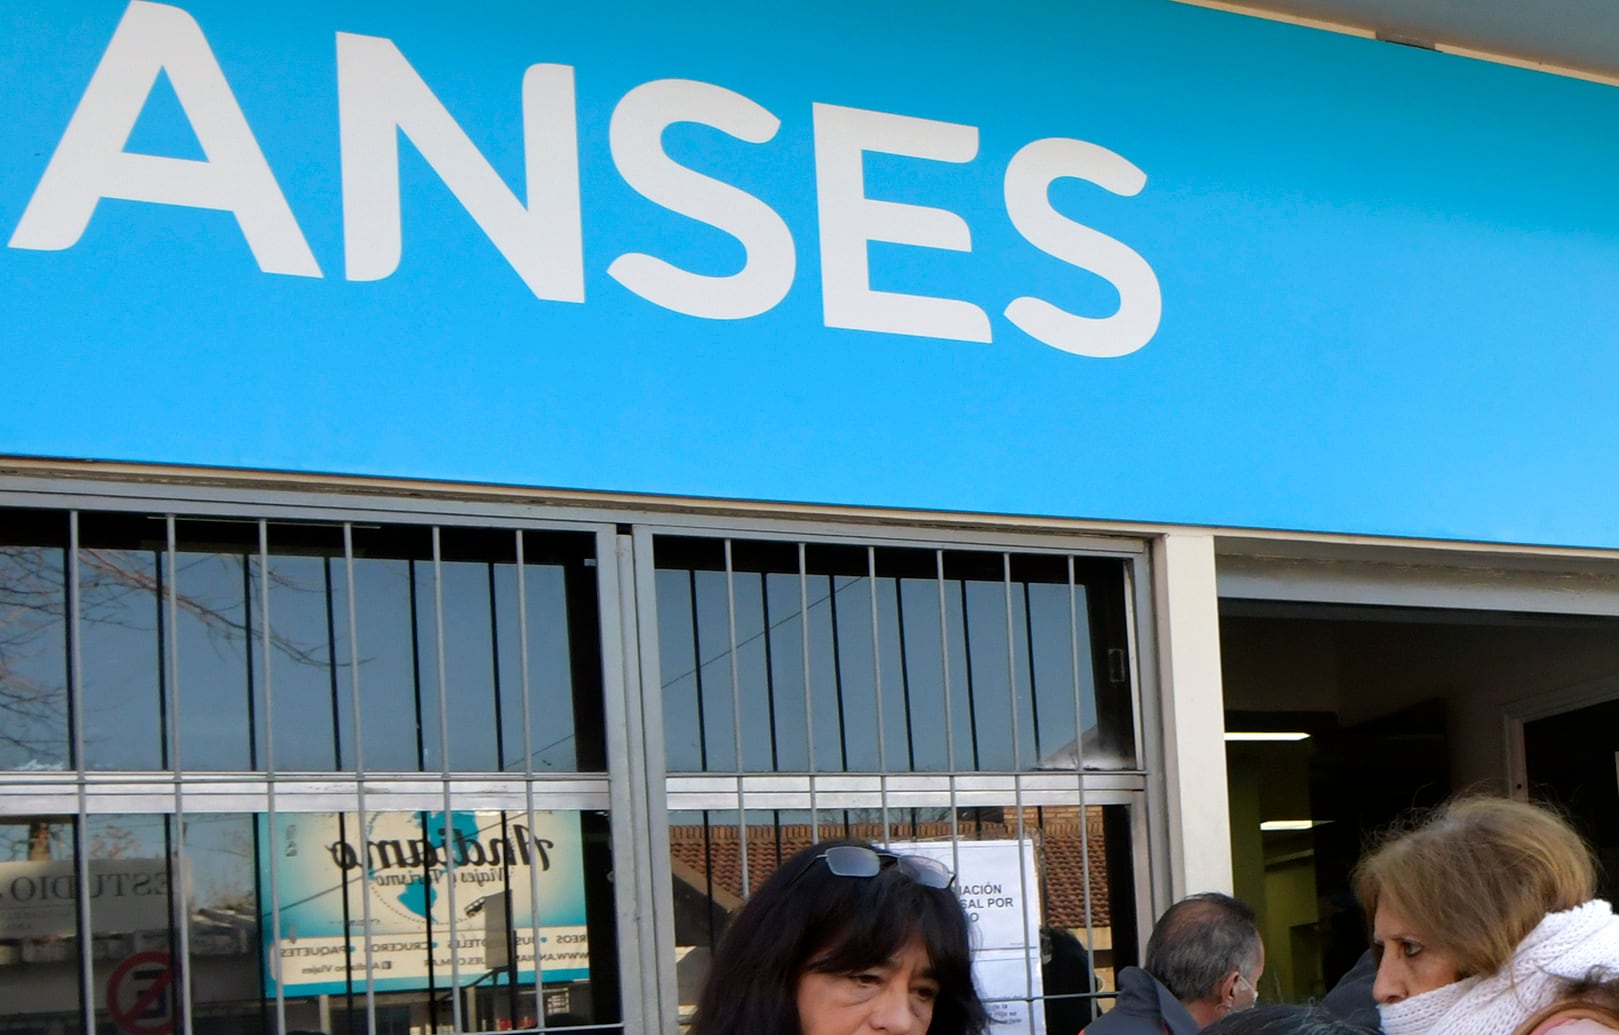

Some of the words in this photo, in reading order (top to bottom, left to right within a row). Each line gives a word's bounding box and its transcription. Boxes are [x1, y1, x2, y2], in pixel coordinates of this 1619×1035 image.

[8, 0, 1163, 358] ANSES
[959, 882, 1002, 895] ACIÓN
[987, 896, 1014, 908] POR
